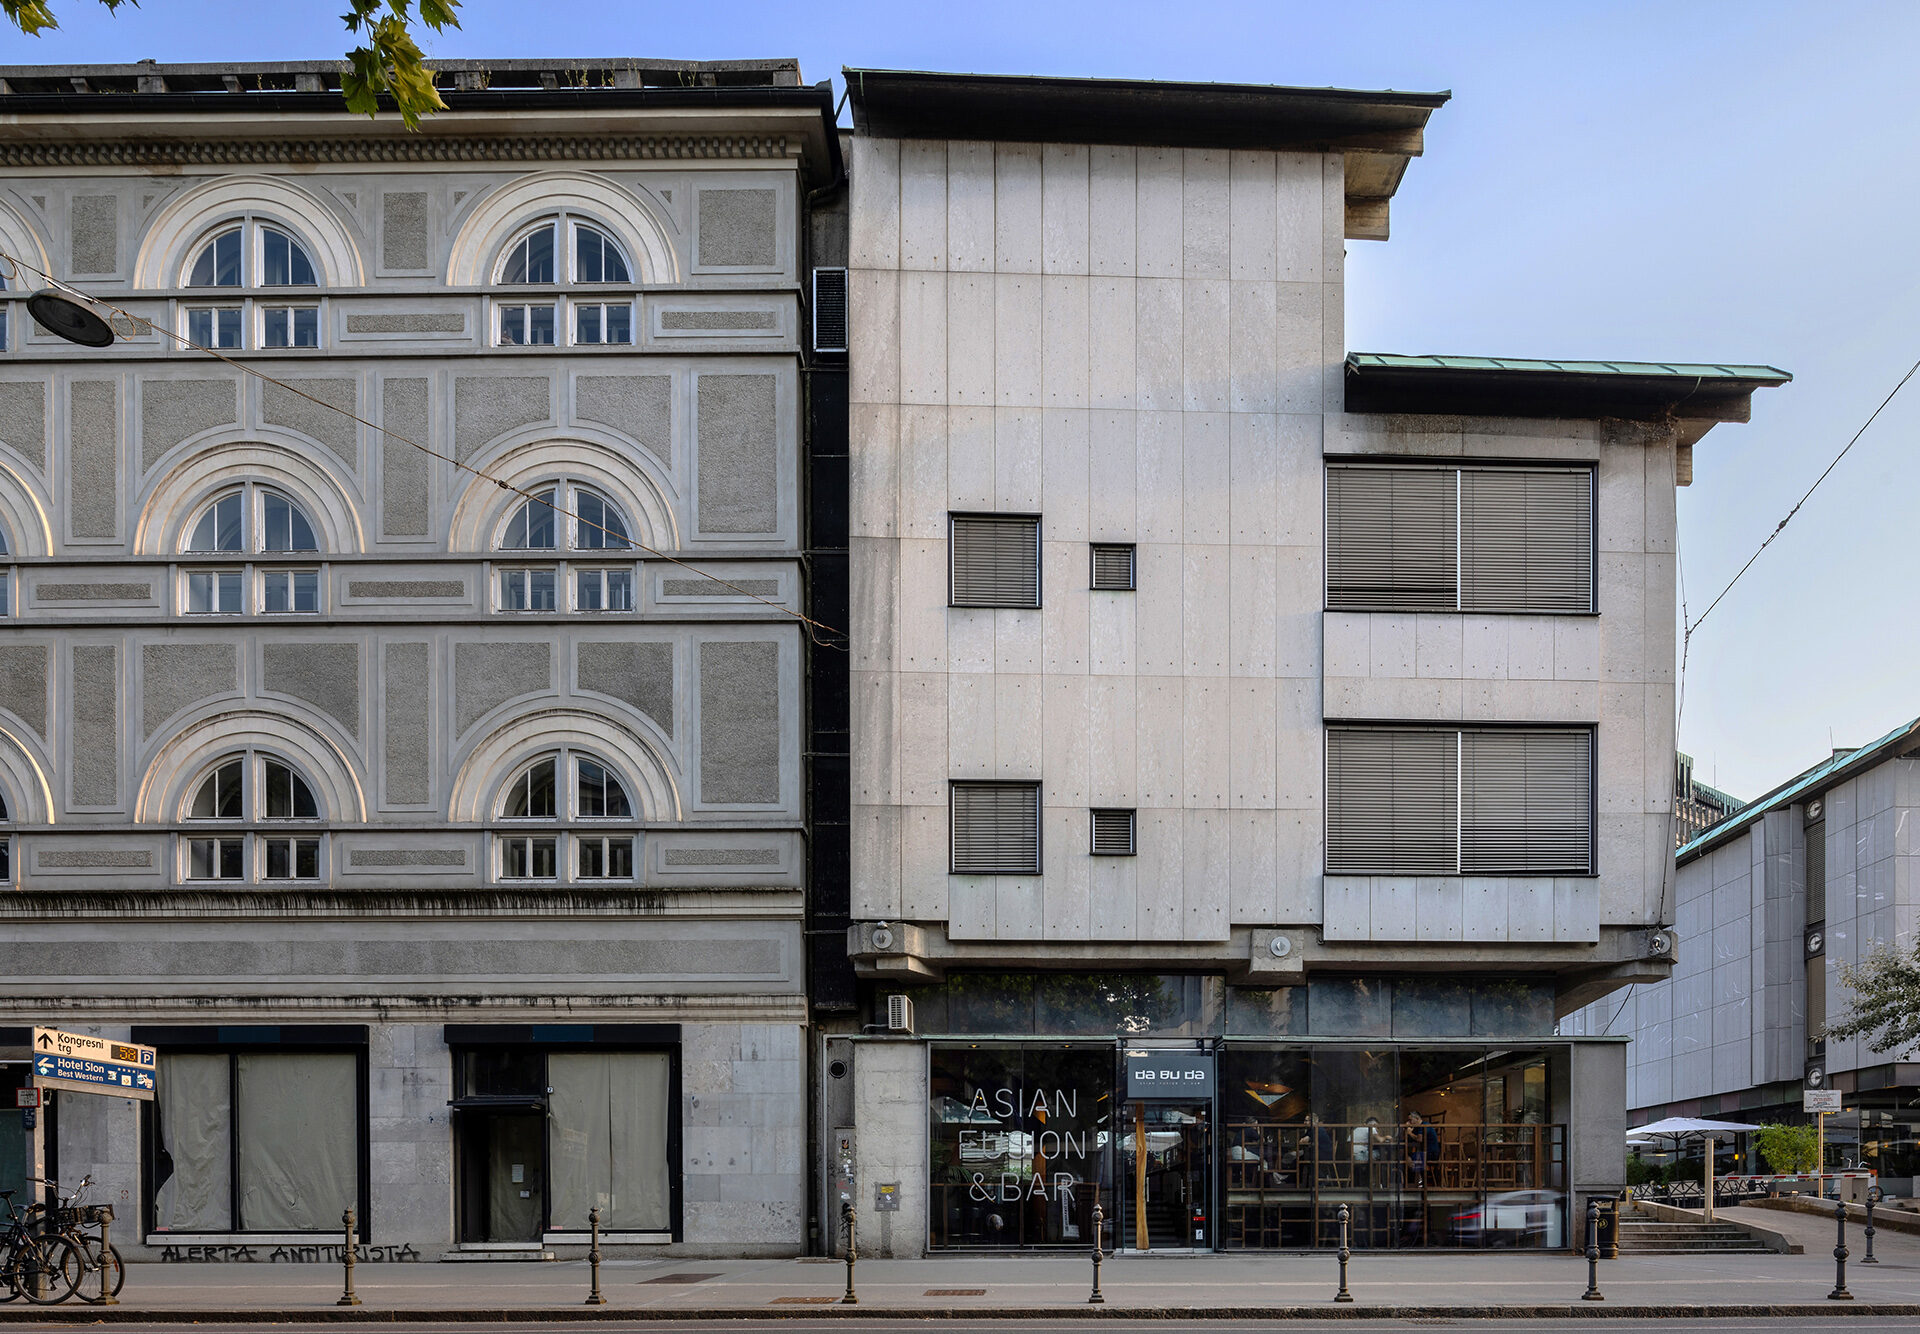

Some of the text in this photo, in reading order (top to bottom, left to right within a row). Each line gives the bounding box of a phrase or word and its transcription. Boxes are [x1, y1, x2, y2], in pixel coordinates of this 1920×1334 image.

[57, 1033, 104, 1049] Kongresni
[58, 1043, 72, 1055] trg
[119, 1047, 137, 1061] 58
[57, 1058, 105, 1073] Hotel Slon
[57, 1069, 104, 1082] Best Western
[1135, 1070, 1155, 1080] da
[1184, 1070, 1205, 1080] da
[968, 1088, 1076, 1118] ASIAN
[959, 1130, 1085, 1160] FUSION
[161, 1244, 257, 1263] ALERTA
